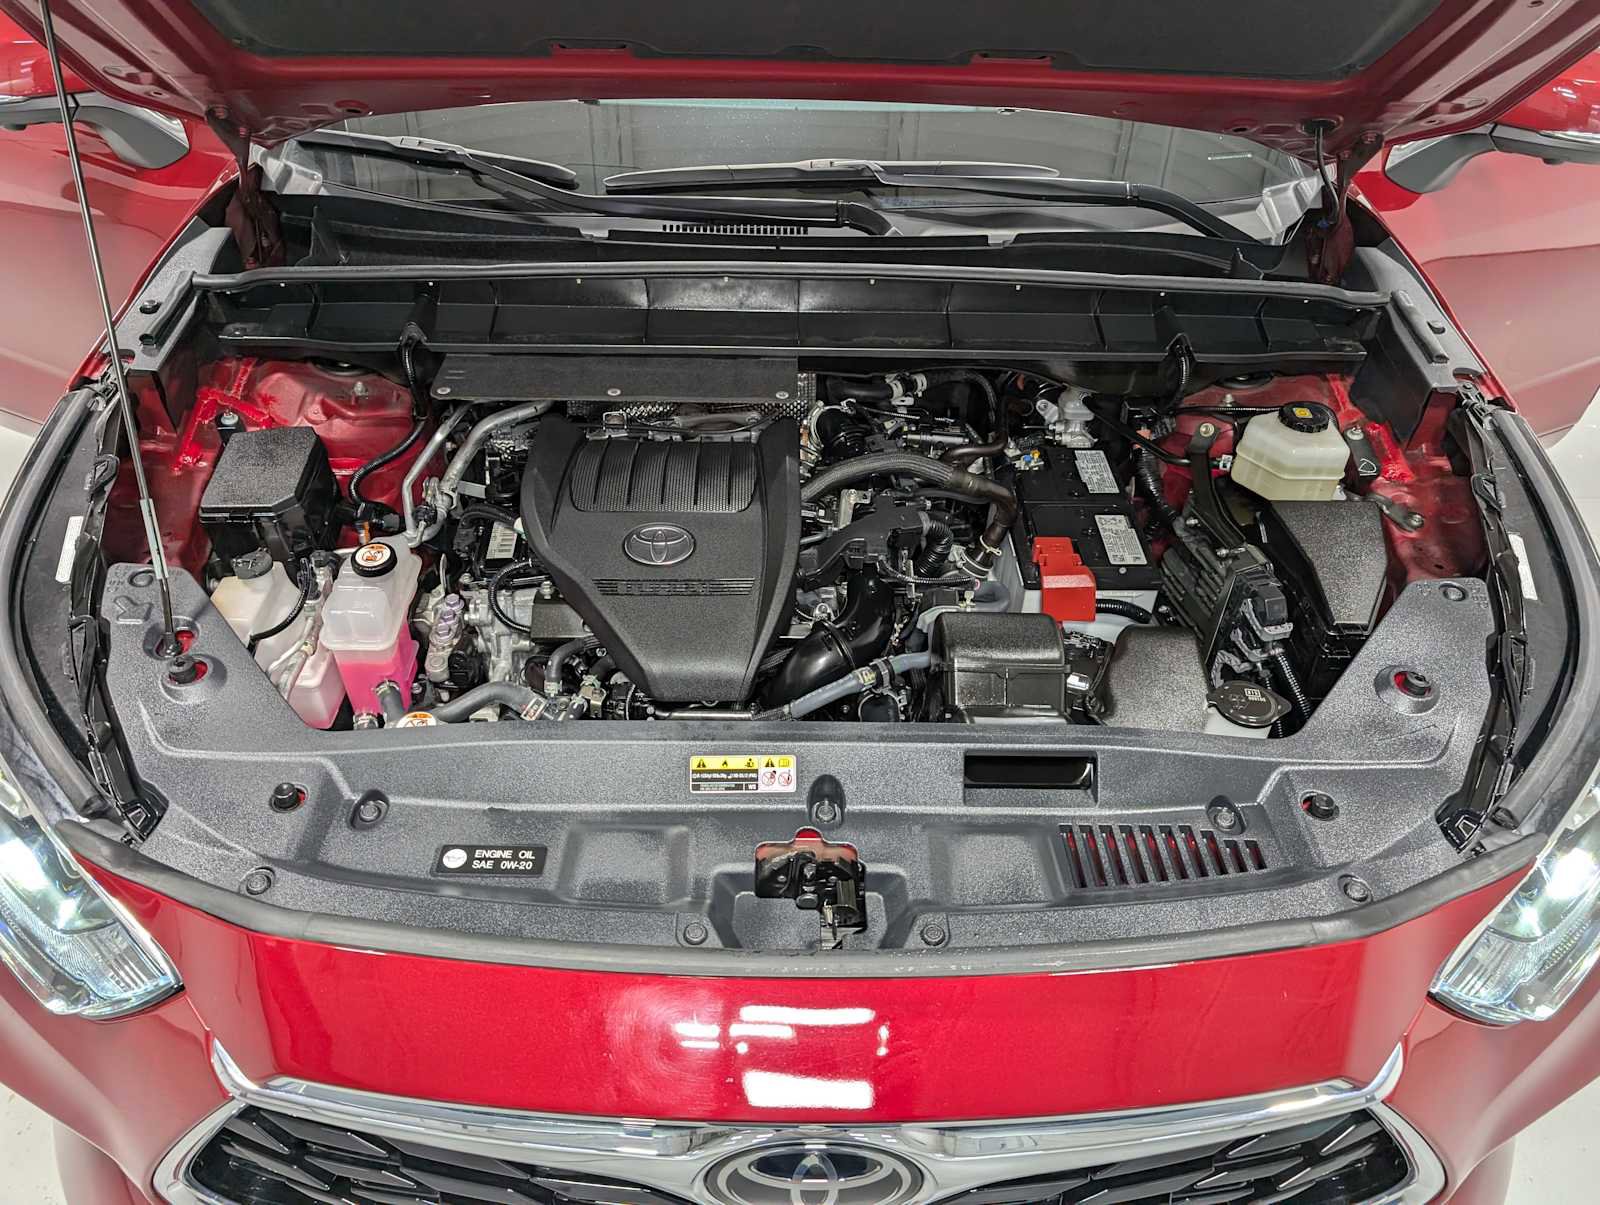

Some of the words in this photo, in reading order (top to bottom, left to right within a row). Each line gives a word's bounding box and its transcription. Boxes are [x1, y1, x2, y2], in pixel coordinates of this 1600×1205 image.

[474, 849, 513, 859] ENGINE
[518, 850, 535, 859] OIL
[472, 859, 494, 869] SAE
[500, 860, 533, 870] 0W-20
